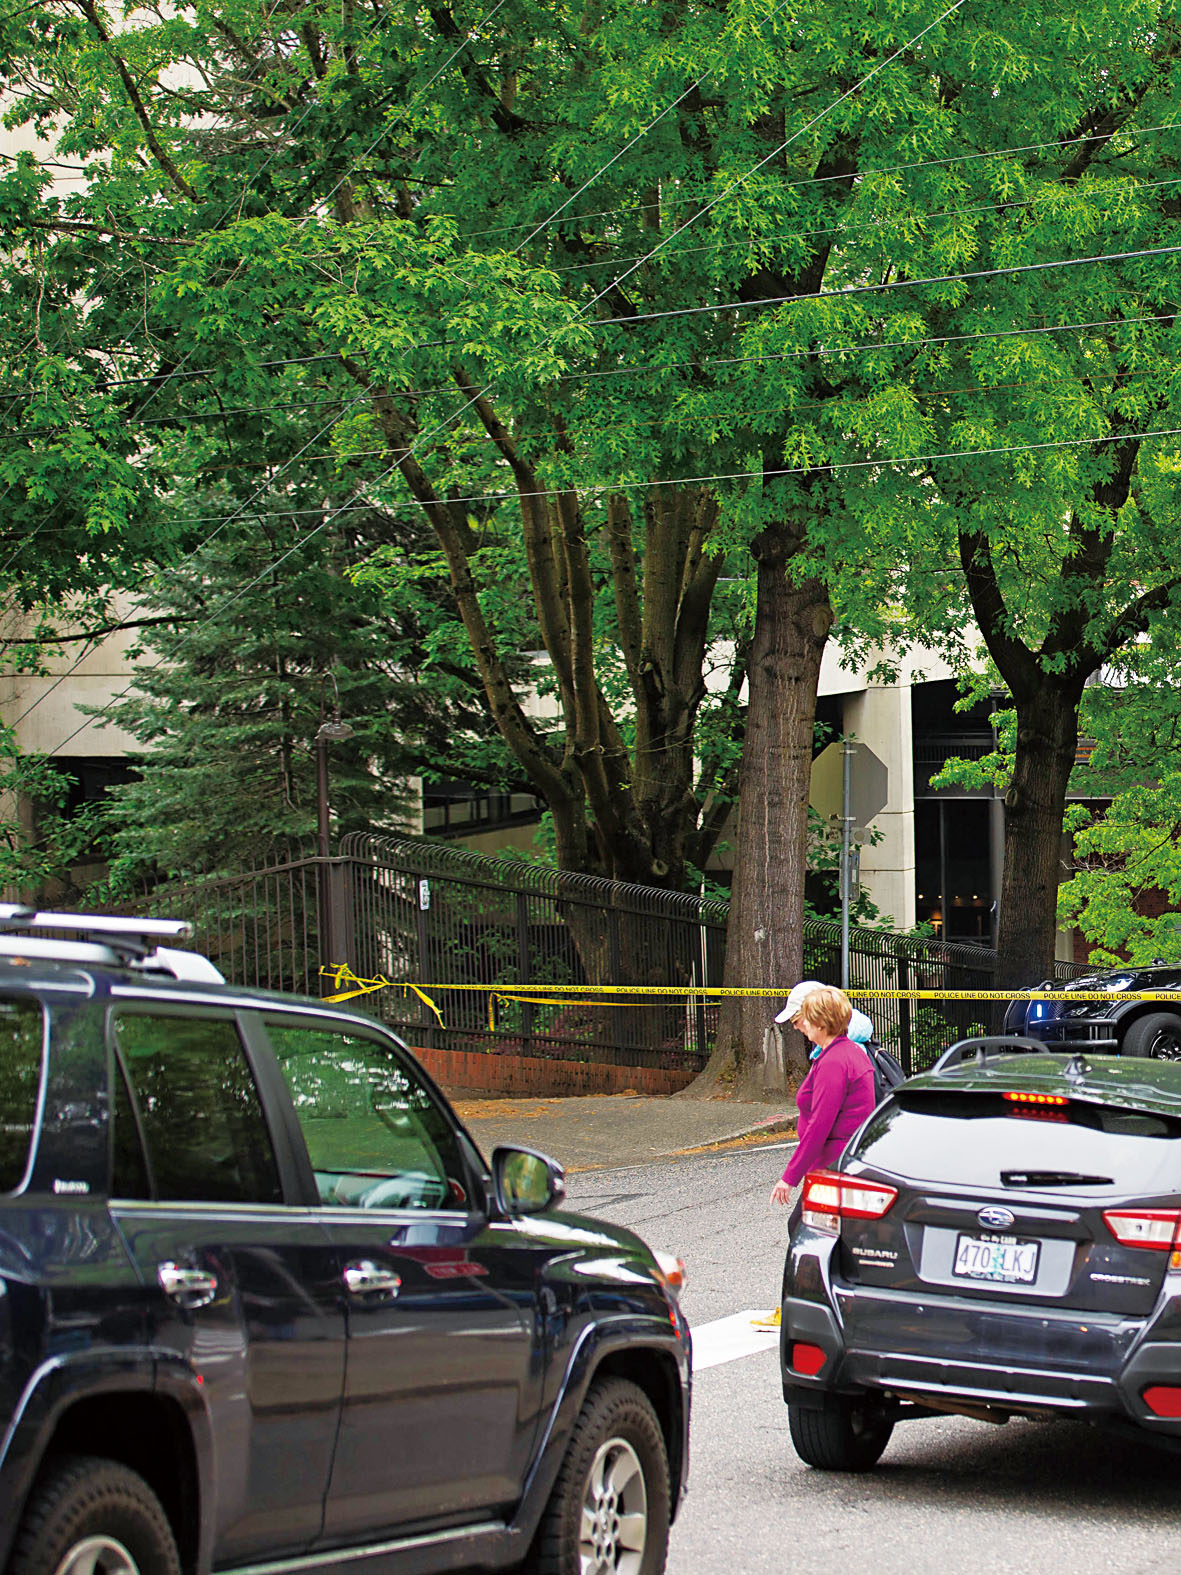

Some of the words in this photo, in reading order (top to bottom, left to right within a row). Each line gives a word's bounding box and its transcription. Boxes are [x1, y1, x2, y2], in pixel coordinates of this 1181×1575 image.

[1044, 992, 1069, 1000] POLICE
[1071, 992, 1086, 1000] LINE
[851, 1247, 899, 1260] SUBARU
[959, 1244, 991, 1268] 470
[1001, 1249, 1036, 1274] LKJ
